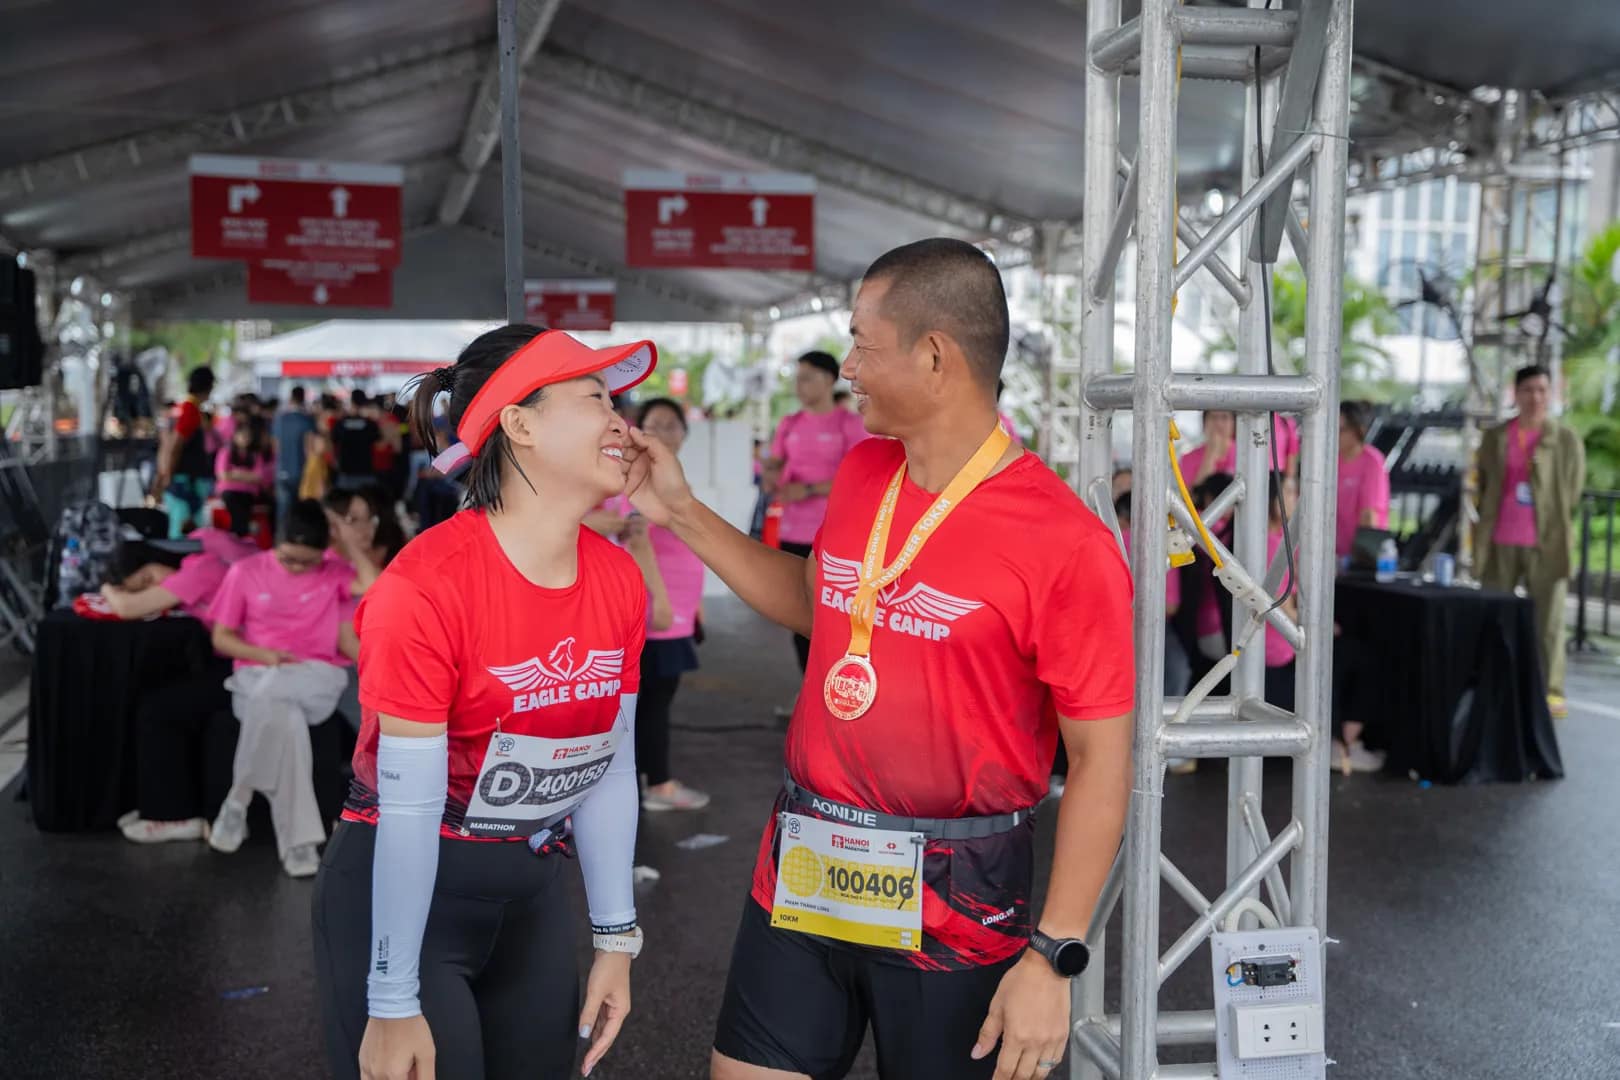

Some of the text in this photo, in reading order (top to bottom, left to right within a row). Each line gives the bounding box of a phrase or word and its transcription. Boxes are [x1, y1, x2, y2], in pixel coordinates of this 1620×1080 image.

[918, 498, 951, 531] 10KM
[821, 586, 951, 642] EAE CAMP
[512, 679, 622, 713] EAGLE CAMP
[568, 744, 592, 753] HANOI
[488, 770, 522, 798] D
[535, 760, 609, 796] 400158
[469, 822, 516, 832] MARATHON
[812, 798, 878, 827] AONIJIE
[844, 837, 870, 847] HANOI
[827, 865, 914, 900] 100406
[779, 914, 799, 923] 10KM
